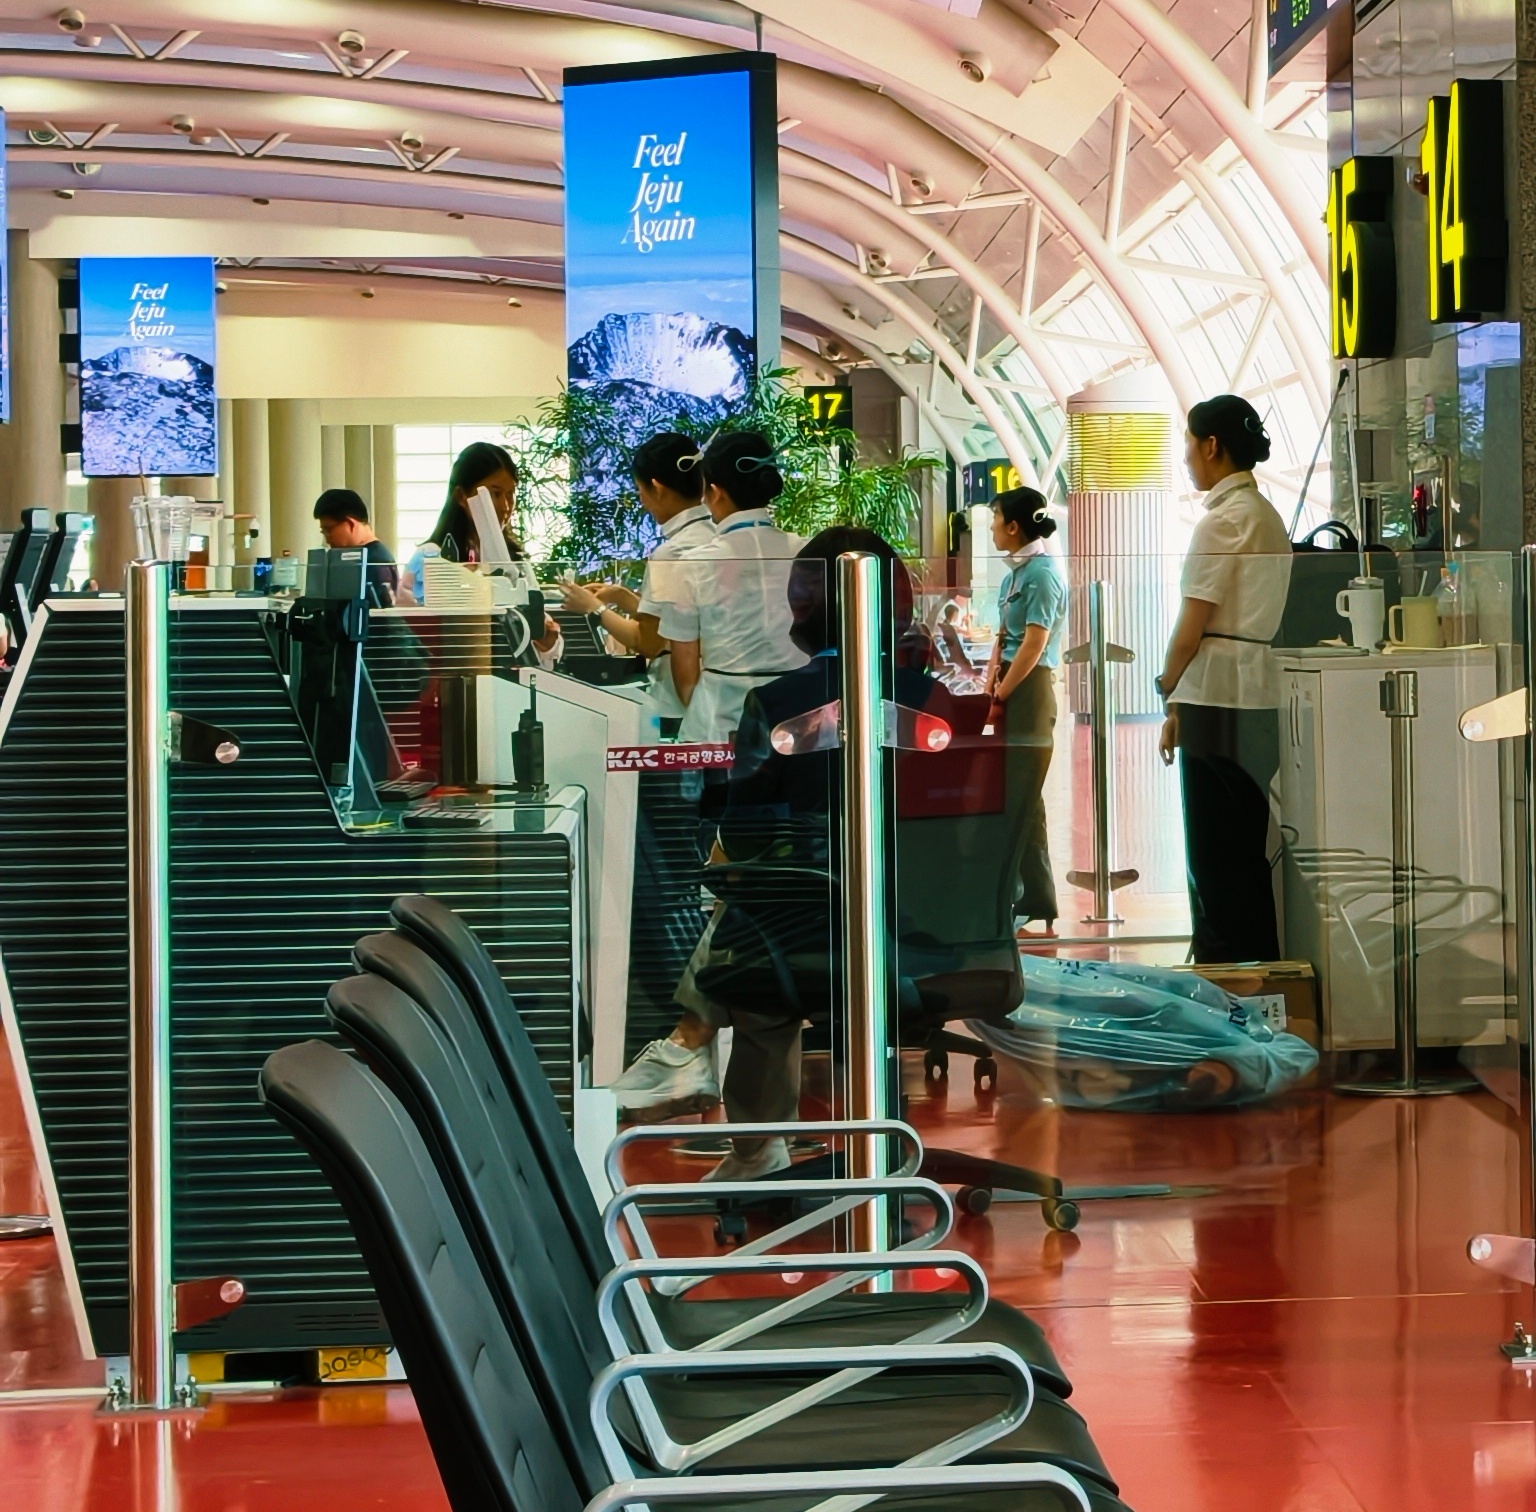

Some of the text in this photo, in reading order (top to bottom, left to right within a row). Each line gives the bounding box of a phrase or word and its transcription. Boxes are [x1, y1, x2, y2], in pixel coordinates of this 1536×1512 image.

[632, 131, 688, 168] Feel
[629, 172, 684, 213] Jeju
[1421, 82, 1464, 321] 14
[620, 210, 696, 253] Again
[1326, 158, 1359, 357] 15
[129, 282, 169, 300] Feel
[128, 301, 166, 322] Jeju
[121, 320, 175, 342] Again
[808, 393, 842, 420] 17
[607, 749, 659, 768] KAC
